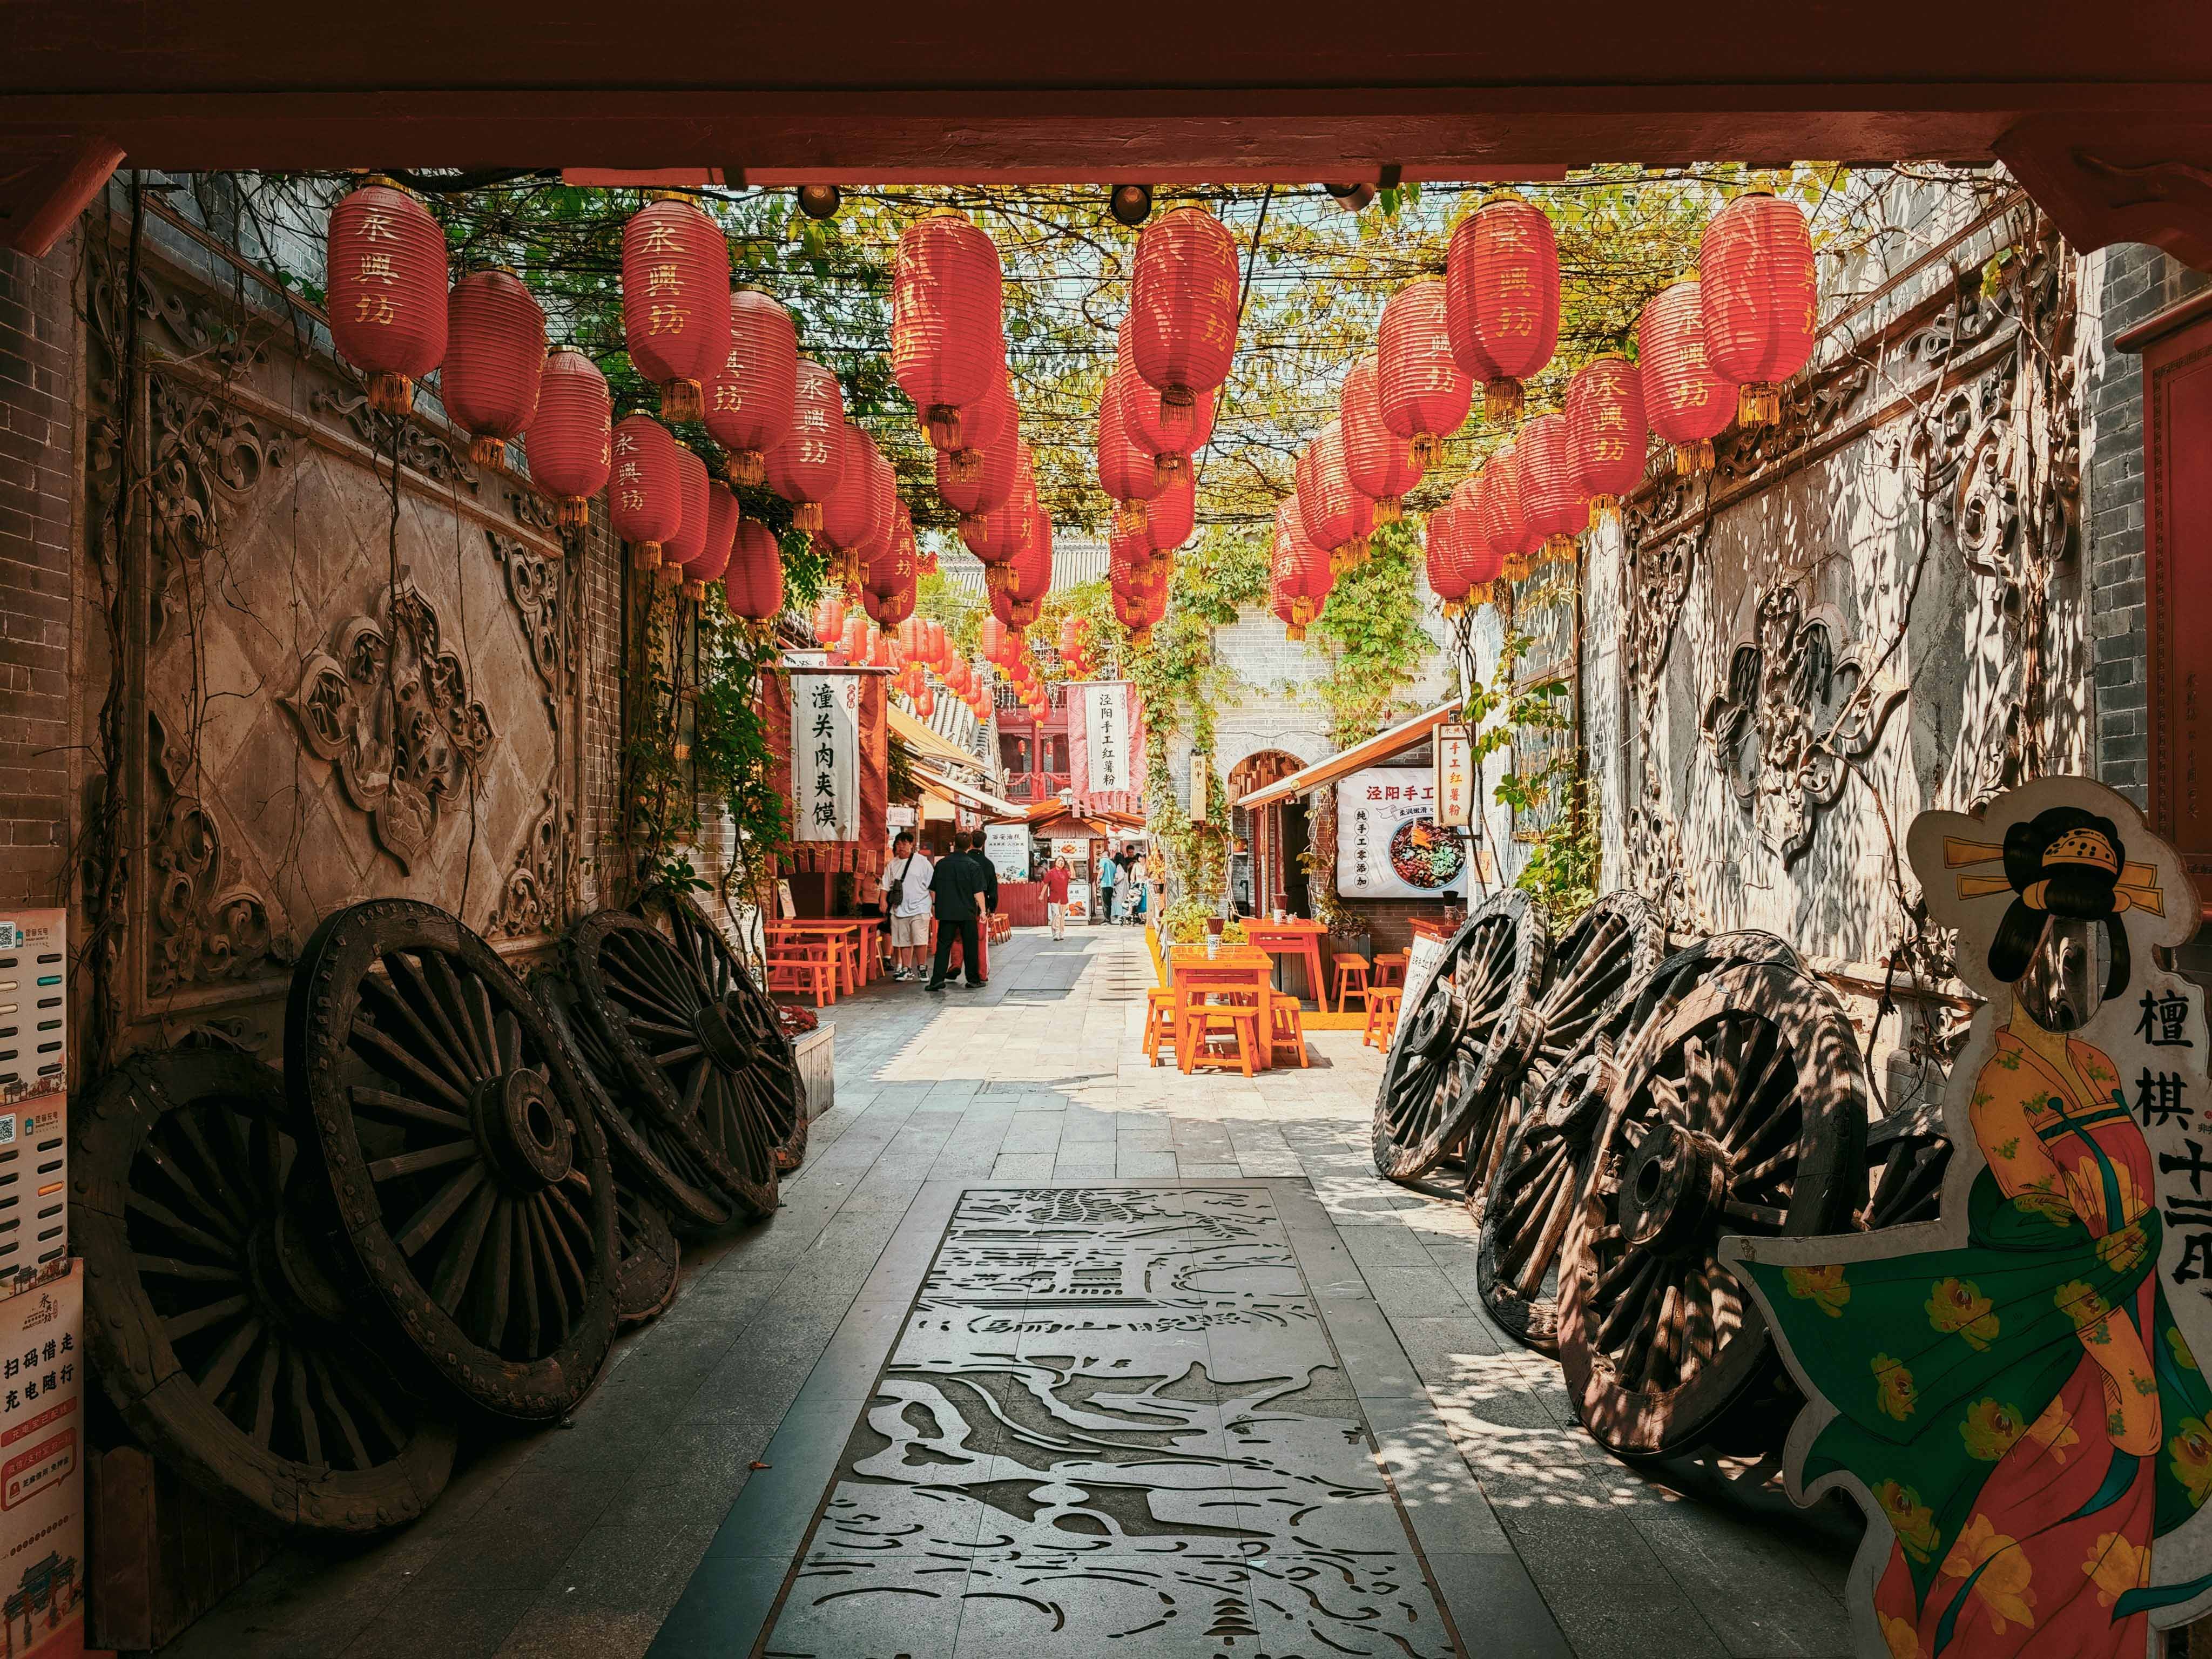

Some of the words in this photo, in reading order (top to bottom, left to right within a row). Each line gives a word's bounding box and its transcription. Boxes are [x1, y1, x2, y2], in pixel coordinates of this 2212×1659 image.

[351, 208, 402, 326] 永興坊
[640, 220, 691, 336] 永興坊
[798, 375, 830, 464] 永興坊
[1593, 373, 1629, 461] 永興坊
[614, 432, 647, 512] 永興坊
[894, 512, 913, 577] 永興坊
[812, 685, 837, 827] 潼关肉夹馍
[1100, 694, 1115, 786] 泾阳手工红薯粉
[1449, 742, 1462, 816] 手工红薯粉
[1366, 786, 1433, 800] 泾阳手工
[1357, 811, 1367, 886] 纯手工零添加
[2133, 989, 2194, 1130] 檀棋
[4, 1333, 73, 1379] 扫码借走
[4, 1364, 73, 1412] 充电随行
